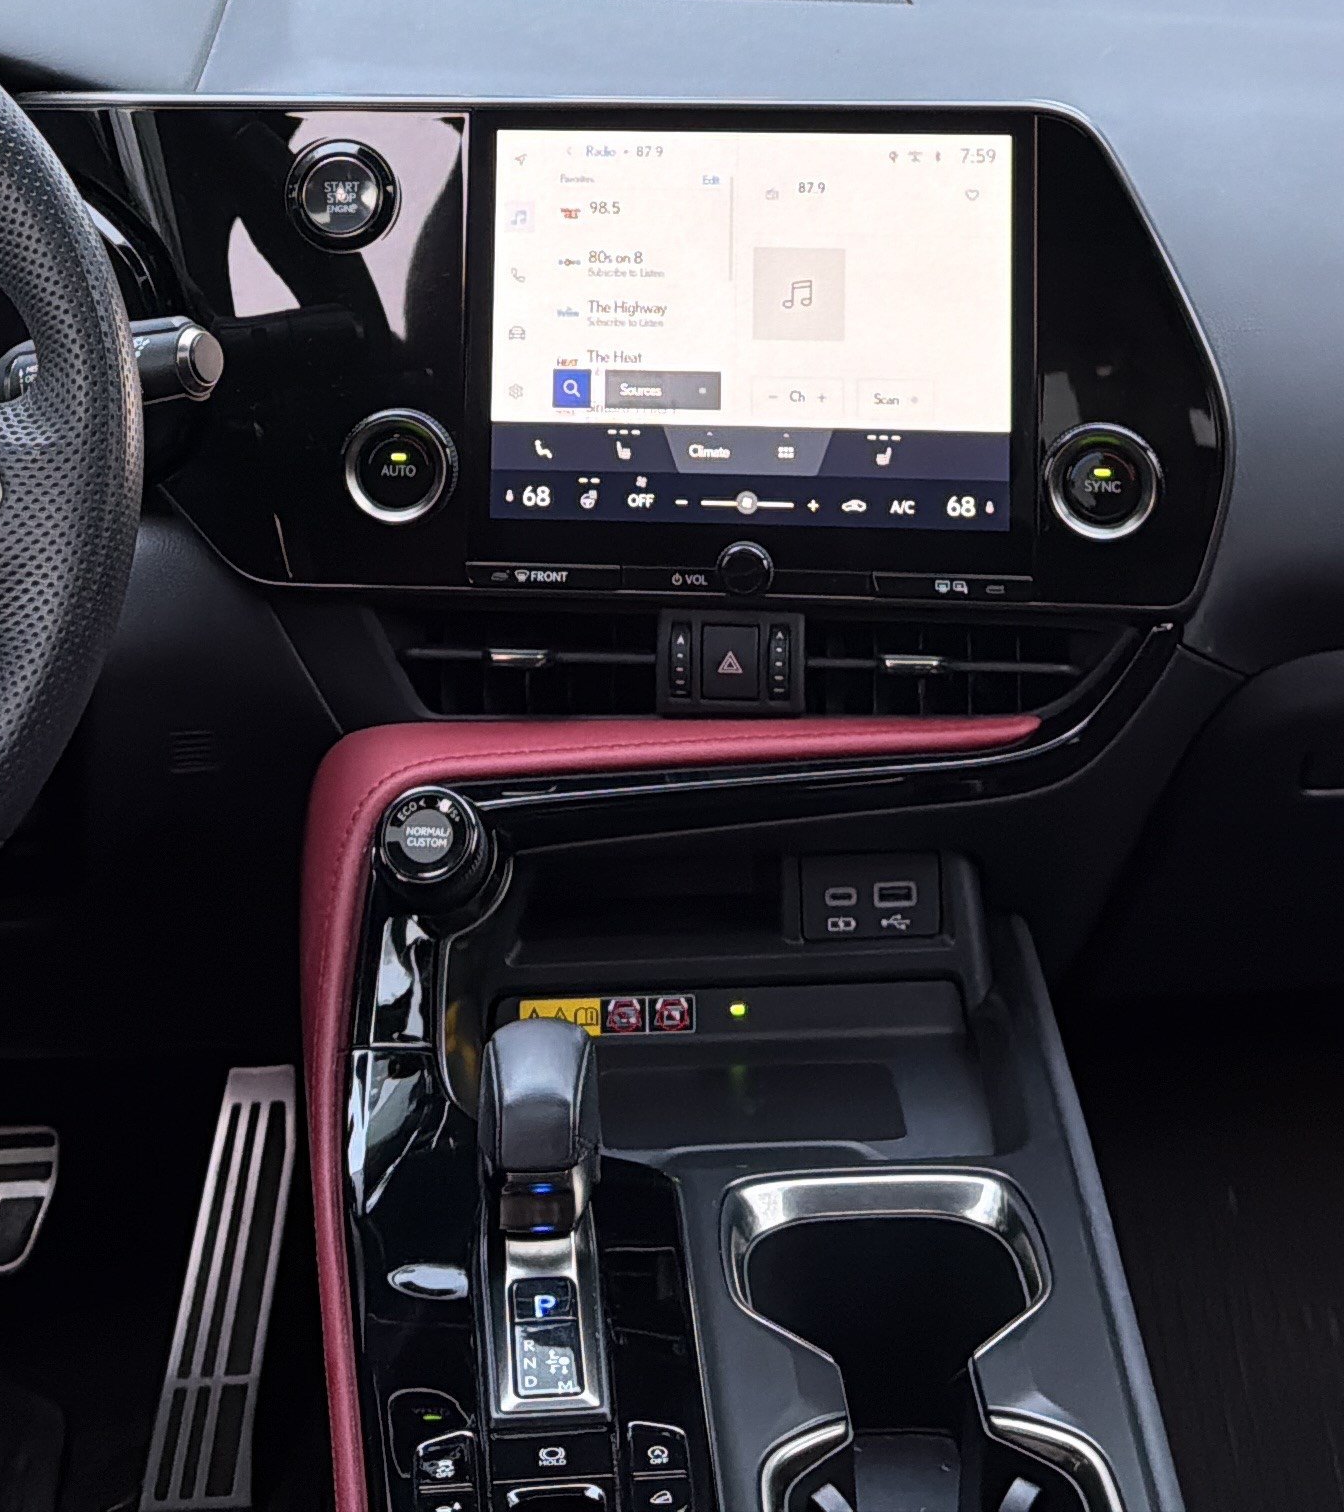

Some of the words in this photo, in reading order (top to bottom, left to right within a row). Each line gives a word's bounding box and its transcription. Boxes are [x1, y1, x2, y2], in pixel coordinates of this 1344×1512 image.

[585, 145, 616, 157] Radio
[959, 148, 997, 164] 7:59
[324, 181, 360, 193] START
[701, 175, 721, 185] Edit
[326, 192, 356, 204] STOP
[327, 204, 358, 214] ENGINE
[589, 200, 621, 215] 98.5
[588, 250, 613, 264] 80s
[615, 252, 631, 264] on
[633, 250, 644, 264] 8
[587, 299, 611, 314] The
[614, 300, 668, 318] Highway
[587, 349, 610, 364] The
[613, 350, 642, 364] Heat
[619, 383, 663, 397] Sources
[789, 390, 806, 403] Ch
[873, 392, 900, 406] Scan
[688, 444, 732, 459] Climate
[380, 464, 417, 478] AUTO
[1084, 479, 1122, 494] SYNC
[522, 485, 551, 507] 68
[627, 493, 655, 509] OFF
[889, 500, 916, 515] A/C
[946, 495, 976, 518] 68
[530, 570, 568, 583] FRONT
[684, 574, 708, 586] VOL
[397, 801, 418, 822] ECO
[405, 826, 450, 838] NORMAL/
[406, 837, 448, 848] CUSTOM
[534, 1294, 557, 1318] P
[523, 1339, 536, 1352] R
[523, 1356, 537, 1370] N
[524, 1375, 538, 1388] D
[557, 1380, 574, 1394] M
[538, 1458, 567, 1467] HOLD
[649, 1457, 669, 1465] OFF
